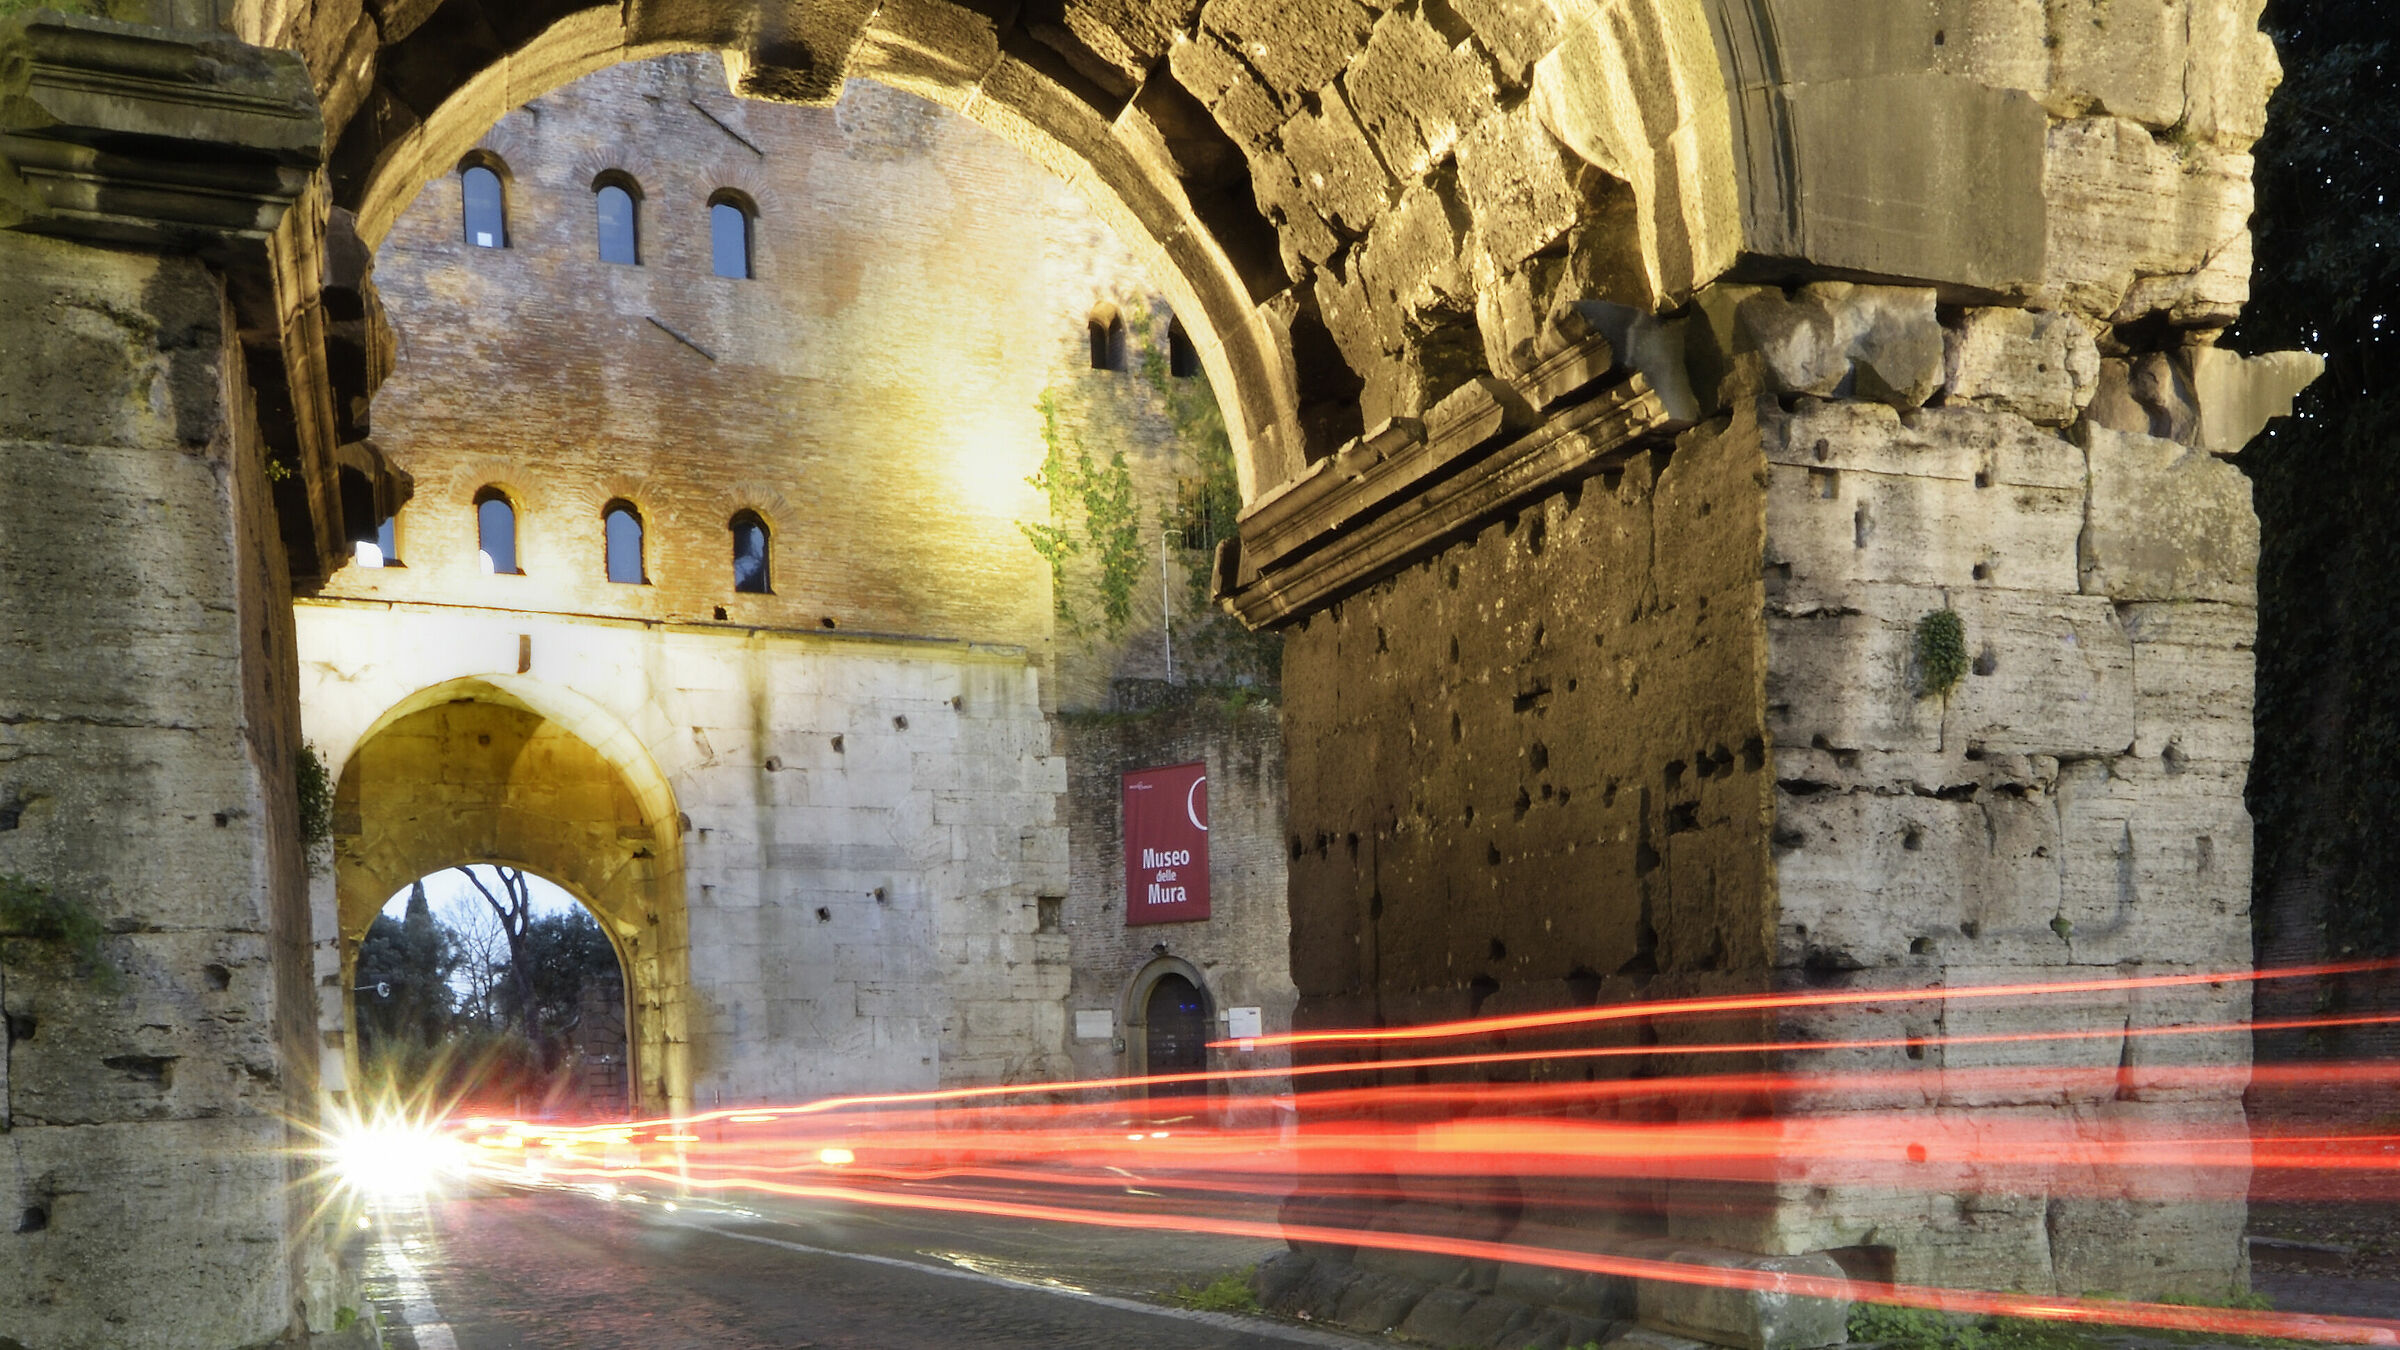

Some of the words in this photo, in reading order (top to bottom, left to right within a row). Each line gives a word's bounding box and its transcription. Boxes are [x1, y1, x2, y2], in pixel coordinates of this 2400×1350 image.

[1143, 848, 1190, 869] Museo
[1156, 869, 1177, 882] delle
[1148, 883, 1187, 905] Mura
